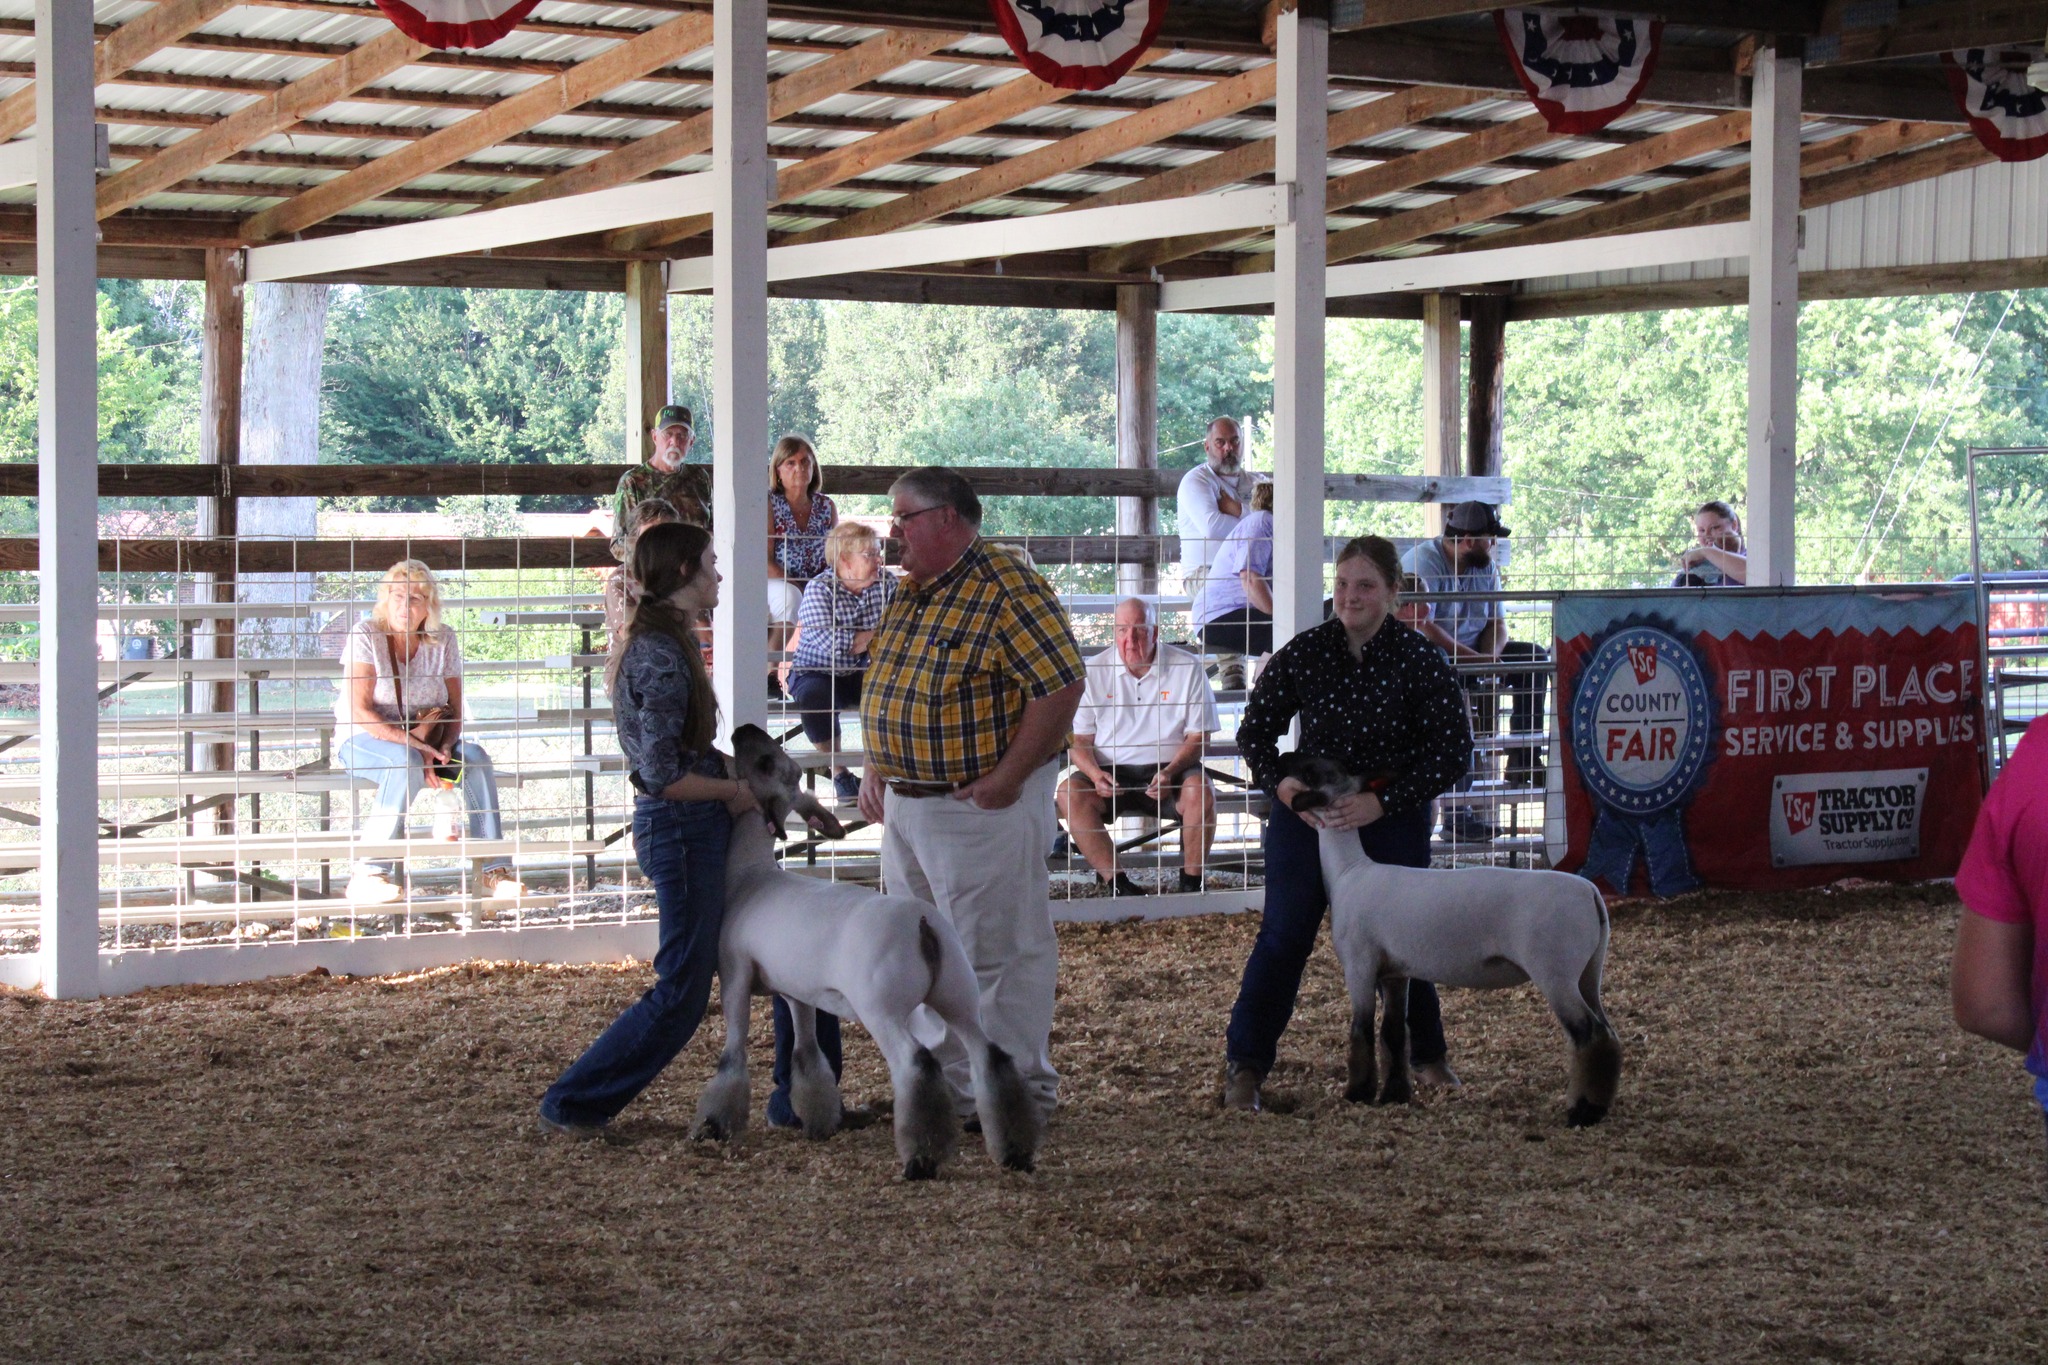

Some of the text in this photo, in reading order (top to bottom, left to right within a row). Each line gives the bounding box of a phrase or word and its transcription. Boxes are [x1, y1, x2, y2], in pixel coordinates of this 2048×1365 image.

[1629, 647, 1655, 677] TSC
[1160, 690, 1170, 701] T
[1727, 660, 1975, 714] FIRST PLACE
[1606, 692, 1682, 713] COUNTY
[1606, 726, 1677, 762] FAIR
[1725, 722, 1827, 756] SERVICE
[1834, 721, 1854, 750] &
[1785, 793, 1812, 826] TSC
[1817, 784, 1917, 811] TRACTOR
[1818, 809, 1895, 836] SUPPLY
